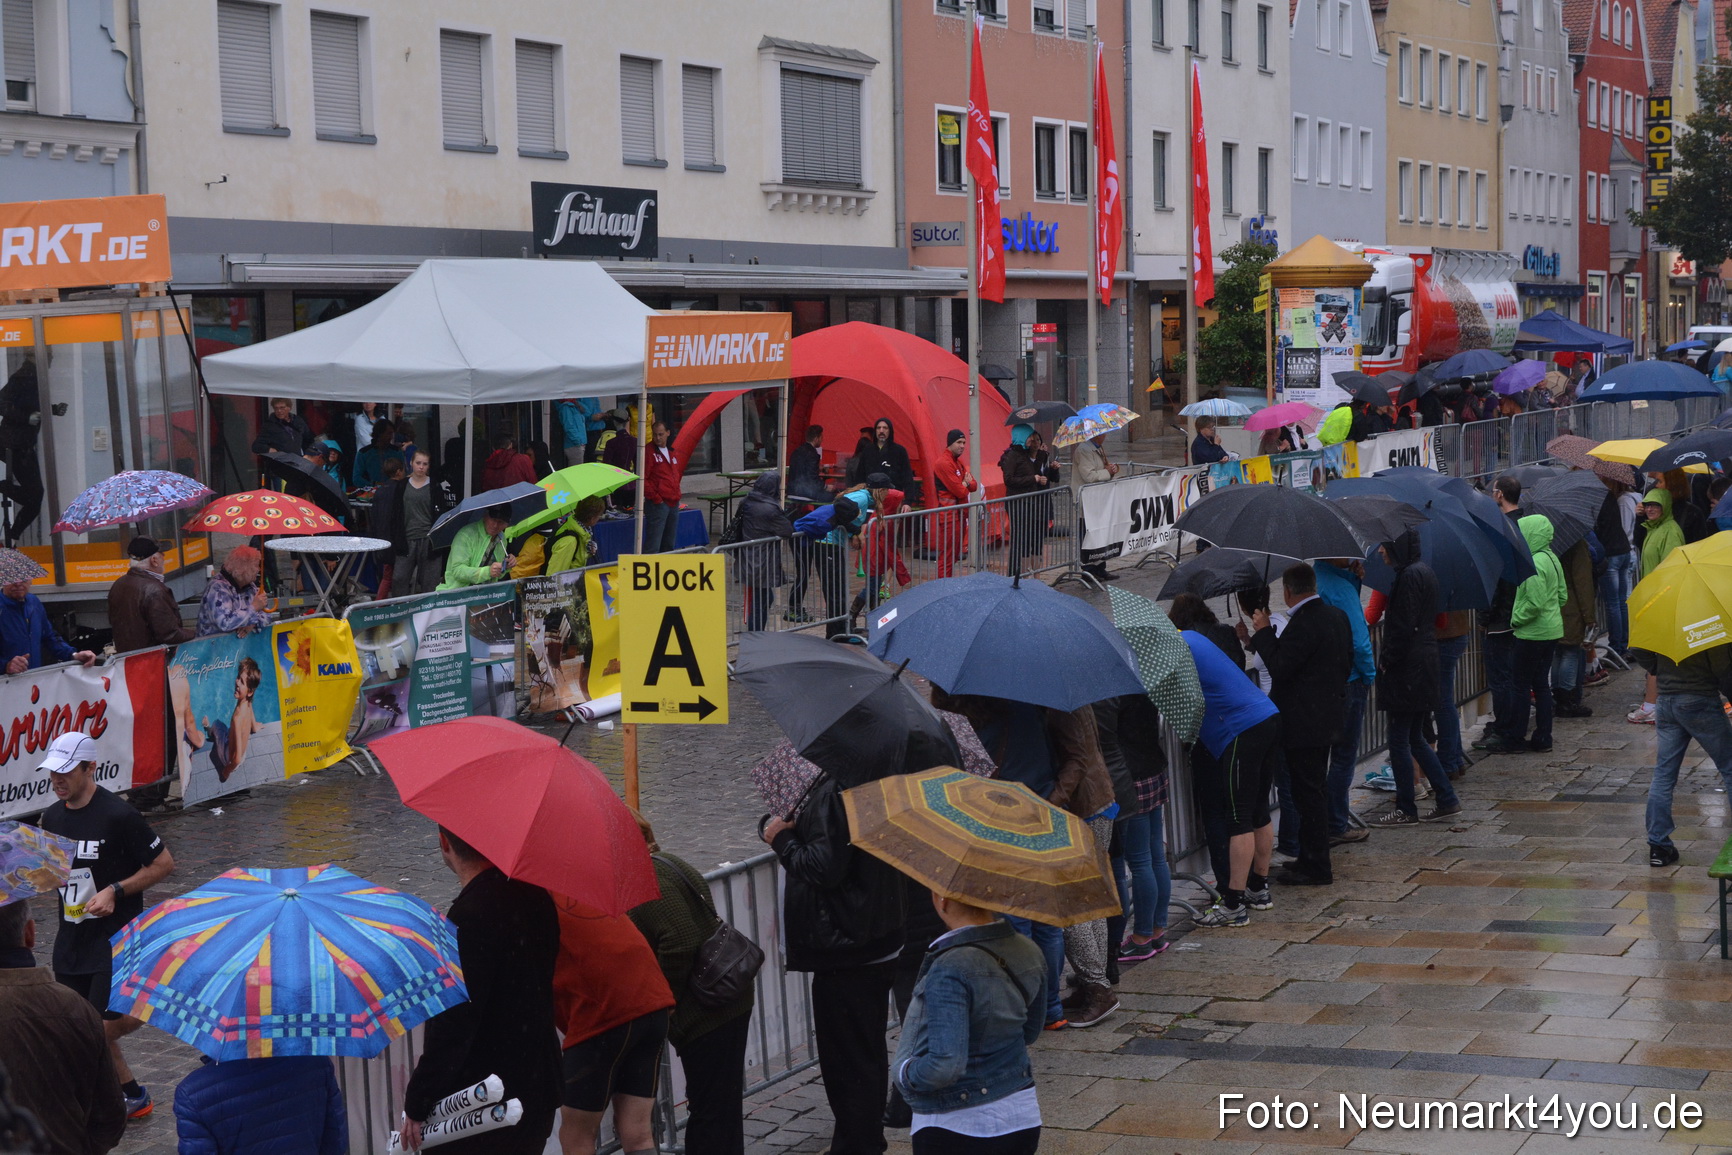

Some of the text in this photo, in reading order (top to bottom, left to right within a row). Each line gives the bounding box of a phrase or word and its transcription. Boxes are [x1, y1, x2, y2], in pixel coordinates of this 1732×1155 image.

[543, 191, 655, 250] frühauf
[913, 226, 960, 242] sutor.
[1494, 294, 1518, 319] AVIA
[652, 332, 785, 368] RUNMARKT.DE
[632, 562, 715, 591] Block
[643, 606, 705, 687] A
[317, 662, 353, 676] KANN
[449, 1108, 484, 1135] BMW
